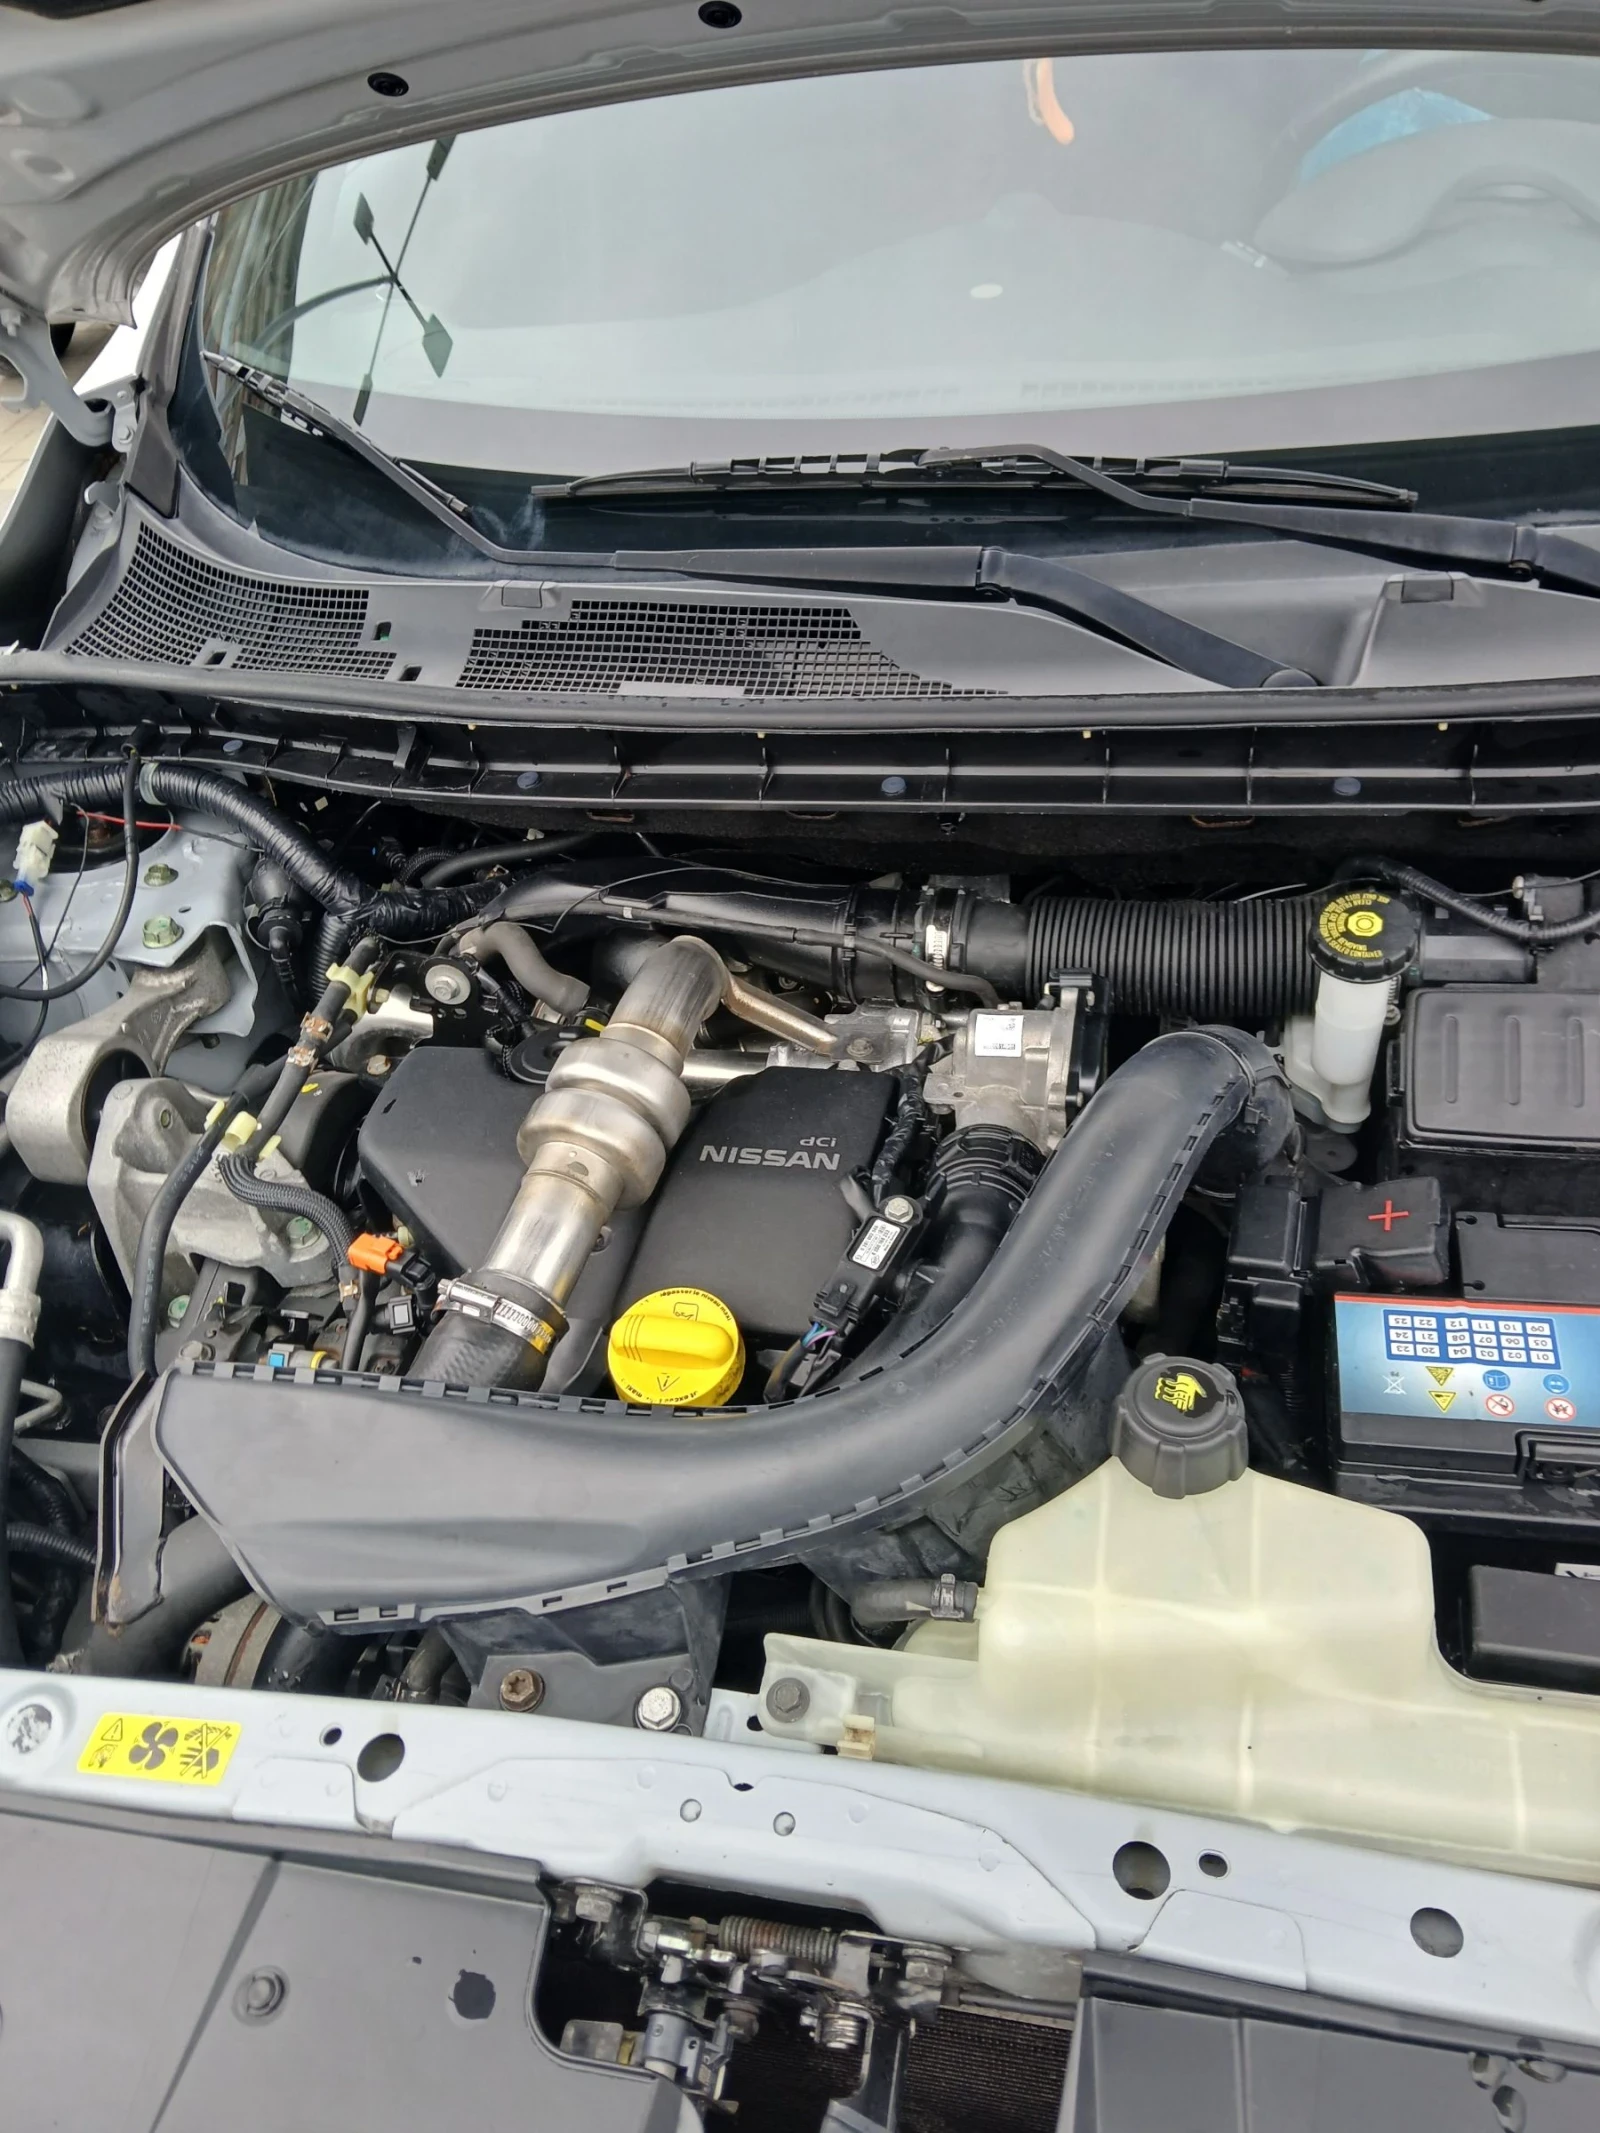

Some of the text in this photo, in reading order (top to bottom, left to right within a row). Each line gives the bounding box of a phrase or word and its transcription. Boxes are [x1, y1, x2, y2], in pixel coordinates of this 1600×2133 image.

[799, 1136, 837, 1148] dCi
[699, 1145, 840, 1171] NISSAN
[701, 1293, 721, 1308] niveau
[720, 1307, 732, 1321] maxi
[1394, 1317, 1408, 1325] 25
[1478, 1322, 1490, 1330] 11
[1503, 1323, 1517, 1331] 10
[1530, 1325, 1545, 1333] 09
[1422, 1333, 1435, 1341] 21
[1452, 1334, 1466, 1342] 08
[1479, 1336, 1493, 1344] 07
[1396, 1345, 1410, 1353] 23
[1453, 1347, 1467, 1355] 04
[1480, 1350, 1495, 1358] 03
[1507, 1351, 1522, 1359] 02
[1536, 1353, 1550, 1361] 01
[626, 1384, 643, 1398] maxi
